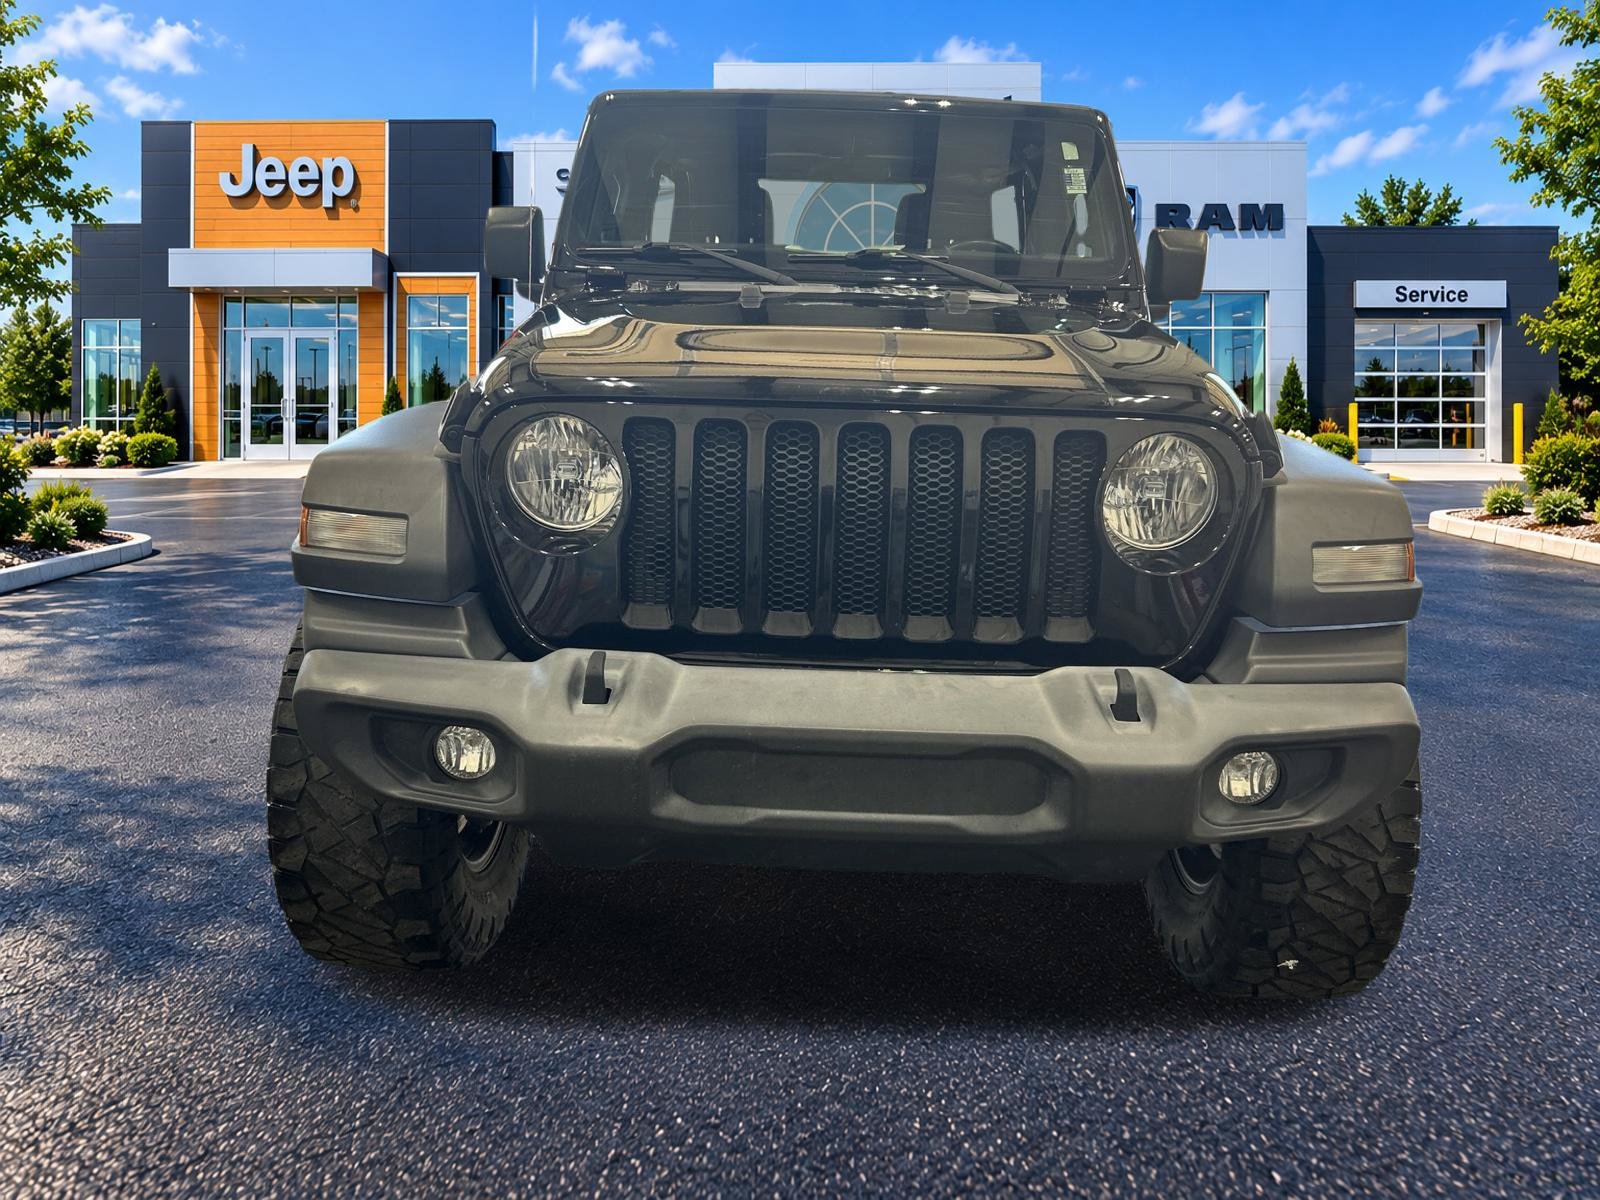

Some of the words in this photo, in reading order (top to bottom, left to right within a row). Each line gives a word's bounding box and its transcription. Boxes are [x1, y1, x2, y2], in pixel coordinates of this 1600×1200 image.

[219, 143, 355, 208] Jeep
[1155, 203, 1285, 231] RAM
[1395, 285, 1468, 303] Service
